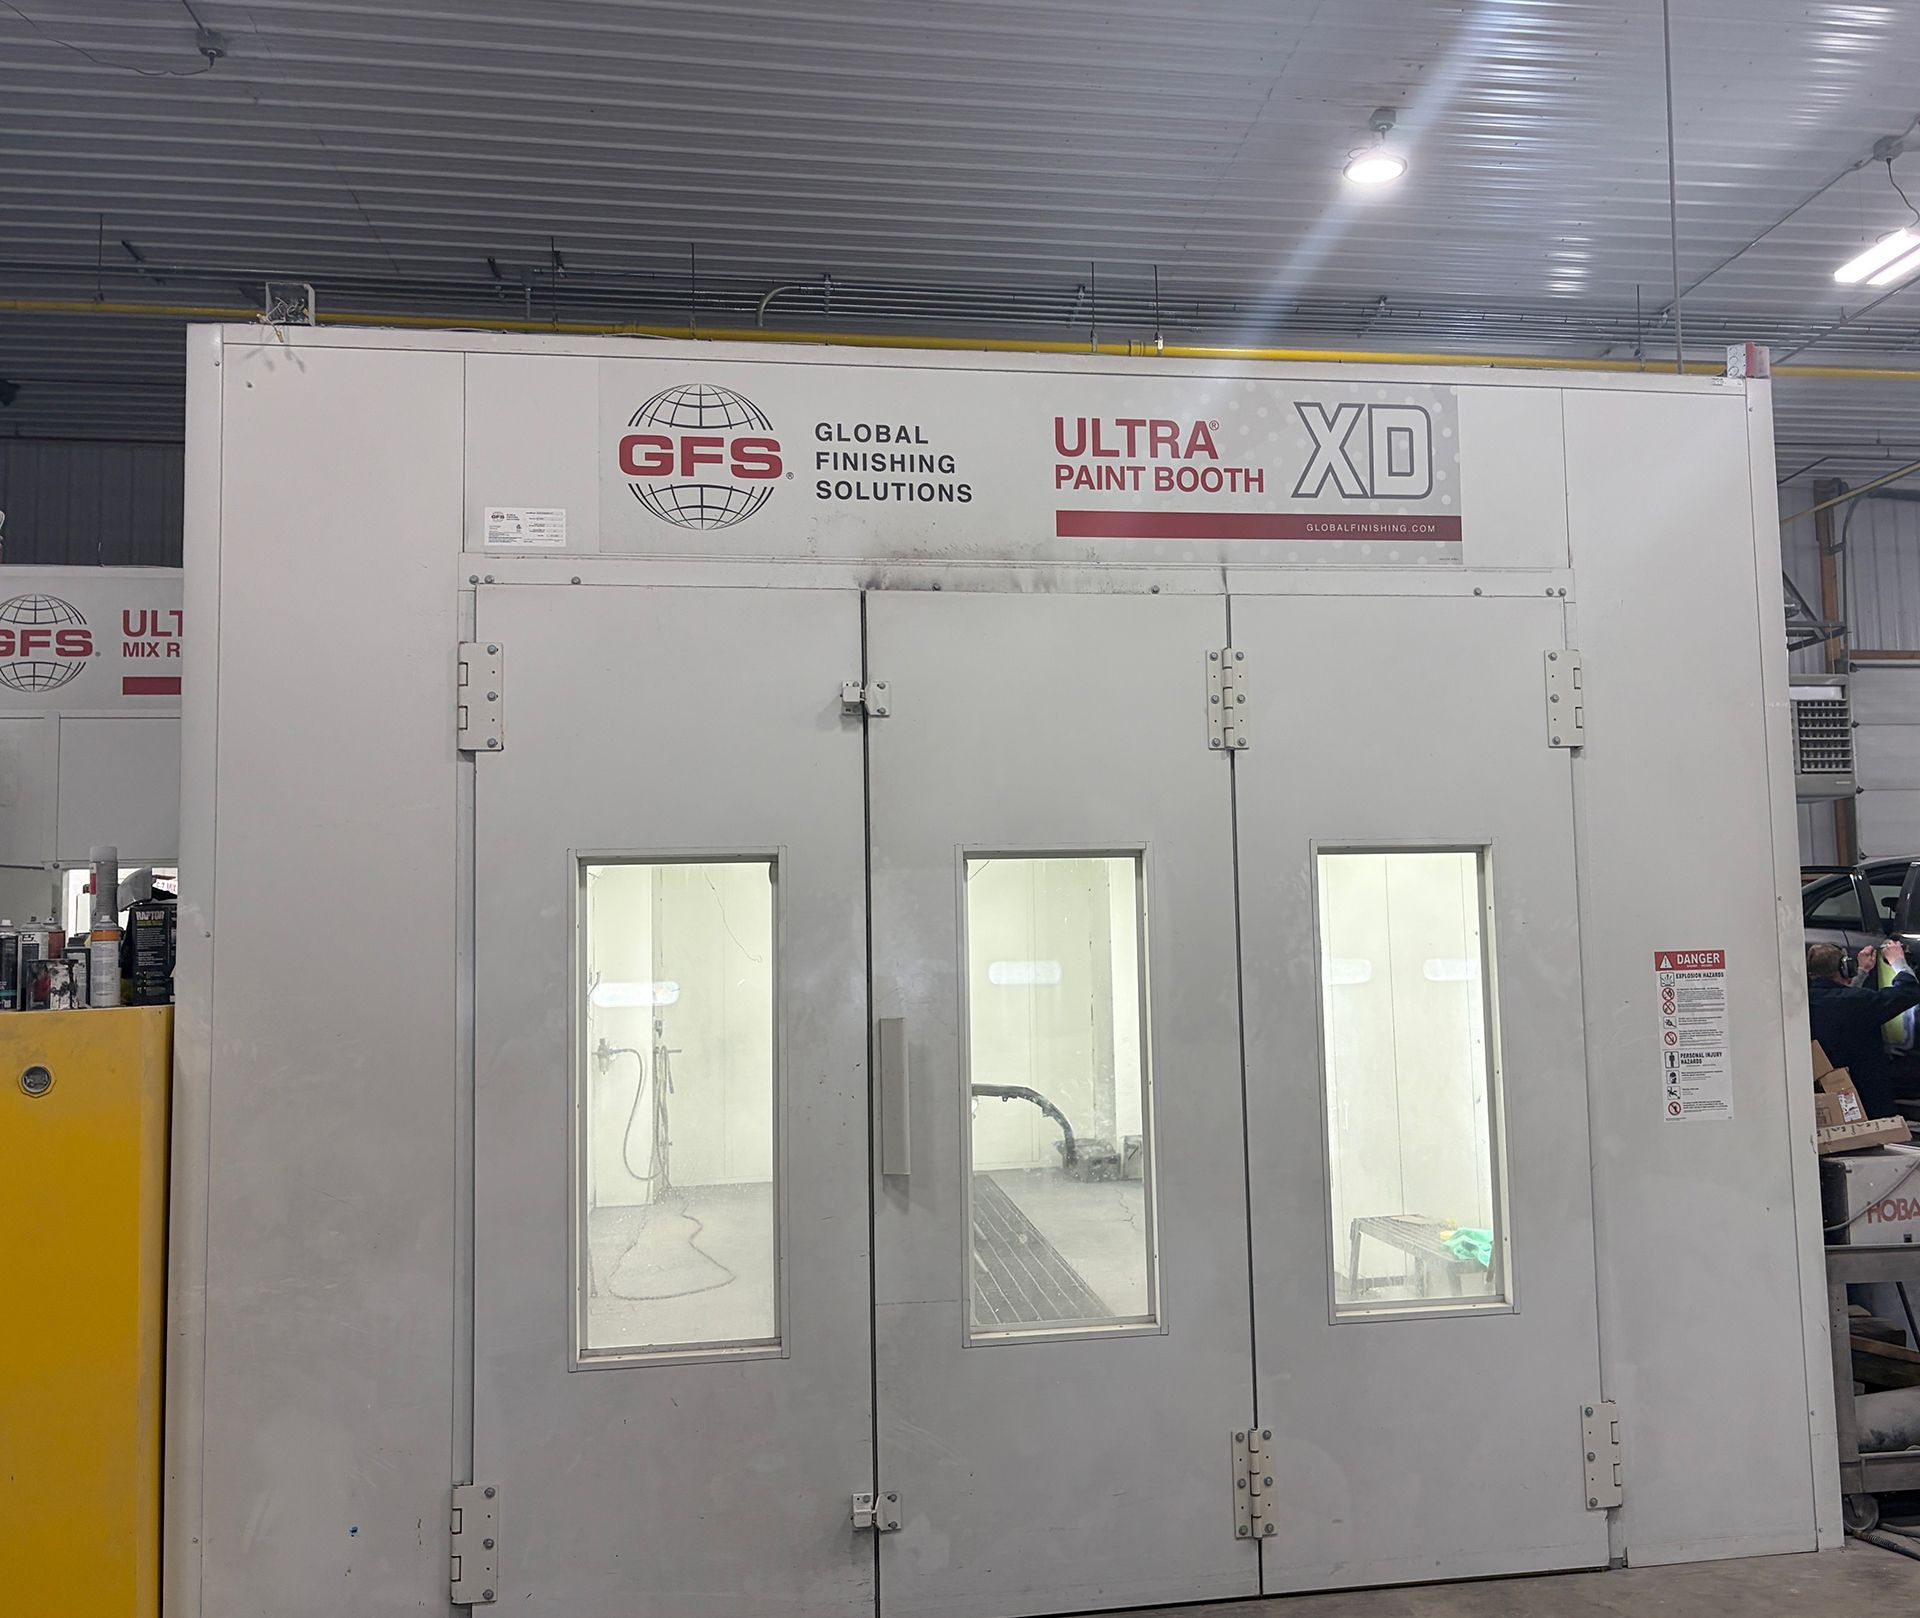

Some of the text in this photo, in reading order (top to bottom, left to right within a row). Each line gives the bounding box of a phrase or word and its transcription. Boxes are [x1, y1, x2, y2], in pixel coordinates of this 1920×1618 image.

[814, 422, 929, 445] GLOBAL
[1291, 401, 1434, 500] XD
[815, 451, 956, 474] FINISHING
[1055, 463, 1264, 494] PAINT BOOTH
[815, 480, 973, 503] SOLUTIONS
[1306, 522, 1436, 533] GLOBALFINISHING.COM
[122, 641, 160, 658] MIX
[136, 911, 165, 921] RAPTOR
[1677, 953, 1720, 965] DANGER
